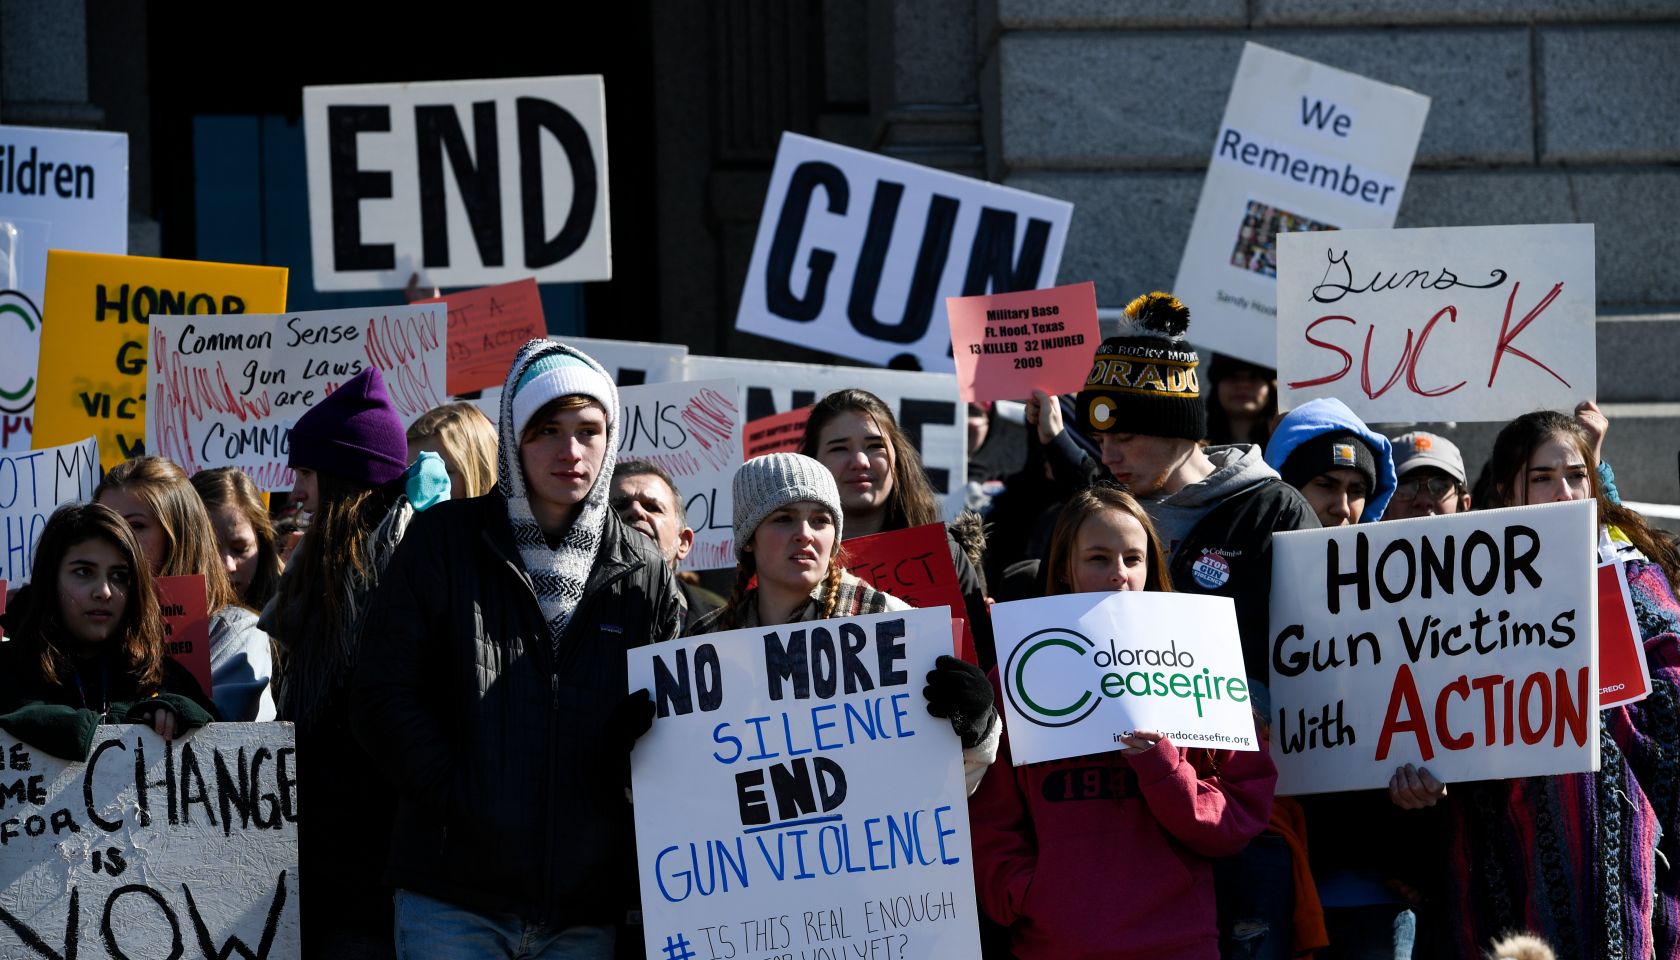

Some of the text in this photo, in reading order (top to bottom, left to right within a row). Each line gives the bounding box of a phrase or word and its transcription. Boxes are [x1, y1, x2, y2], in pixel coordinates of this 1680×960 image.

[1300, 96, 1352, 138] We
[327, 96, 597, 272] END
[1219, 129, 1396, 208] Remember
[765, 161, 1052, 357] GUN
[1308, 248, 1507, 303] Guns
[178, 317, 359, 355] Common Sense
[985, 321, 1065, 338] Ft. Hood, Texas
[986, 305, 1059, 321] Military Base
[1287, 282, 1571, 400] SUCK
[969, 344, 982, 355] 13
[984, 342, 1018, 354] KILLED
[1025, 340, 1039, 352] 32
[1041, 334, 1085, 350] INJURED
[1014, 357, 1043, 369] 2009
[1119, 345, 1165, 358] ROCKY
[240, 360, 285, 395] gun
[274, 389, 314, 407] are
[55, 440, 97, 506] MY
[1193, 569, 1223, 586] VIOLENCE
[1200, 564, 1222, 580] GUN
[1202, 556, 1228, 571] STOP
[1326, 525, 1543, 615] HONOR
[652, 618, 908, 719] NO MORE
[1273, 608, 1576, 677] Gun Victims
[713, 693, 915, 764] SILENCE
[1279, 663, 1589, 761] With ACTION
[0, 737, 297, 846] FOR CHANGE
[735, 756, 847, 825] END
[92, 847, 127, 877] IS
[655, 806, 960, 902] GUN VIOLENCE
[698, 925, 736, 960] IS
[740, 915, 790, 953] THIS
[803, 907, 851, 944] REAL
[865, 891, 956, 933] ENOUGH
